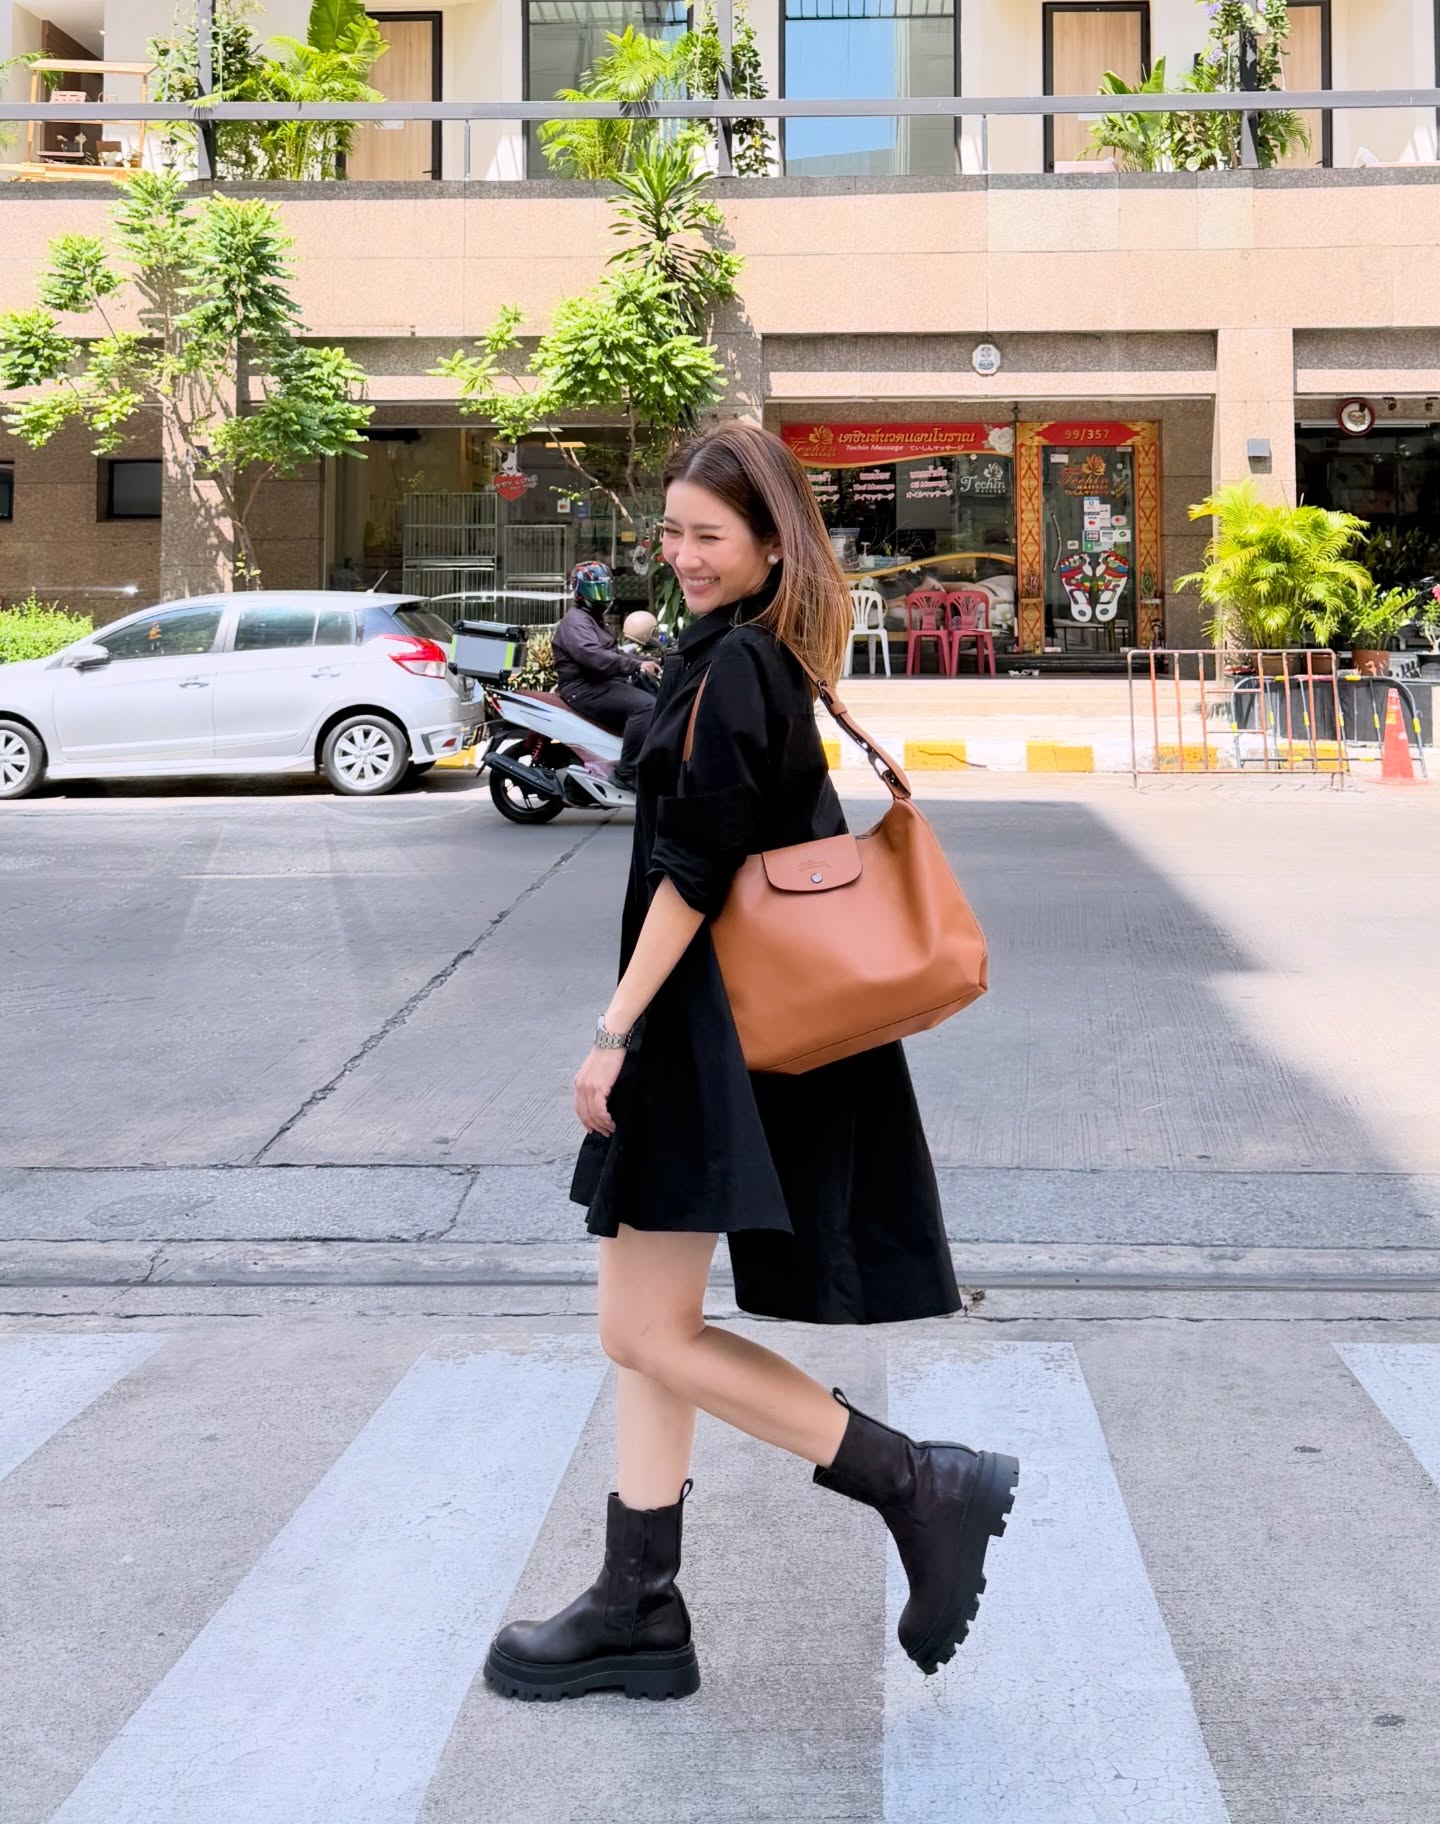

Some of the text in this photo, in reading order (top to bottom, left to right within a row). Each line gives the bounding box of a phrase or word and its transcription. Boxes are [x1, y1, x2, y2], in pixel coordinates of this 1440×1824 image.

[1064, 428, 1110, 441] 99/357
[870, 444, 904, 452] Massage
[959, 475, 1005, 493] Techin
